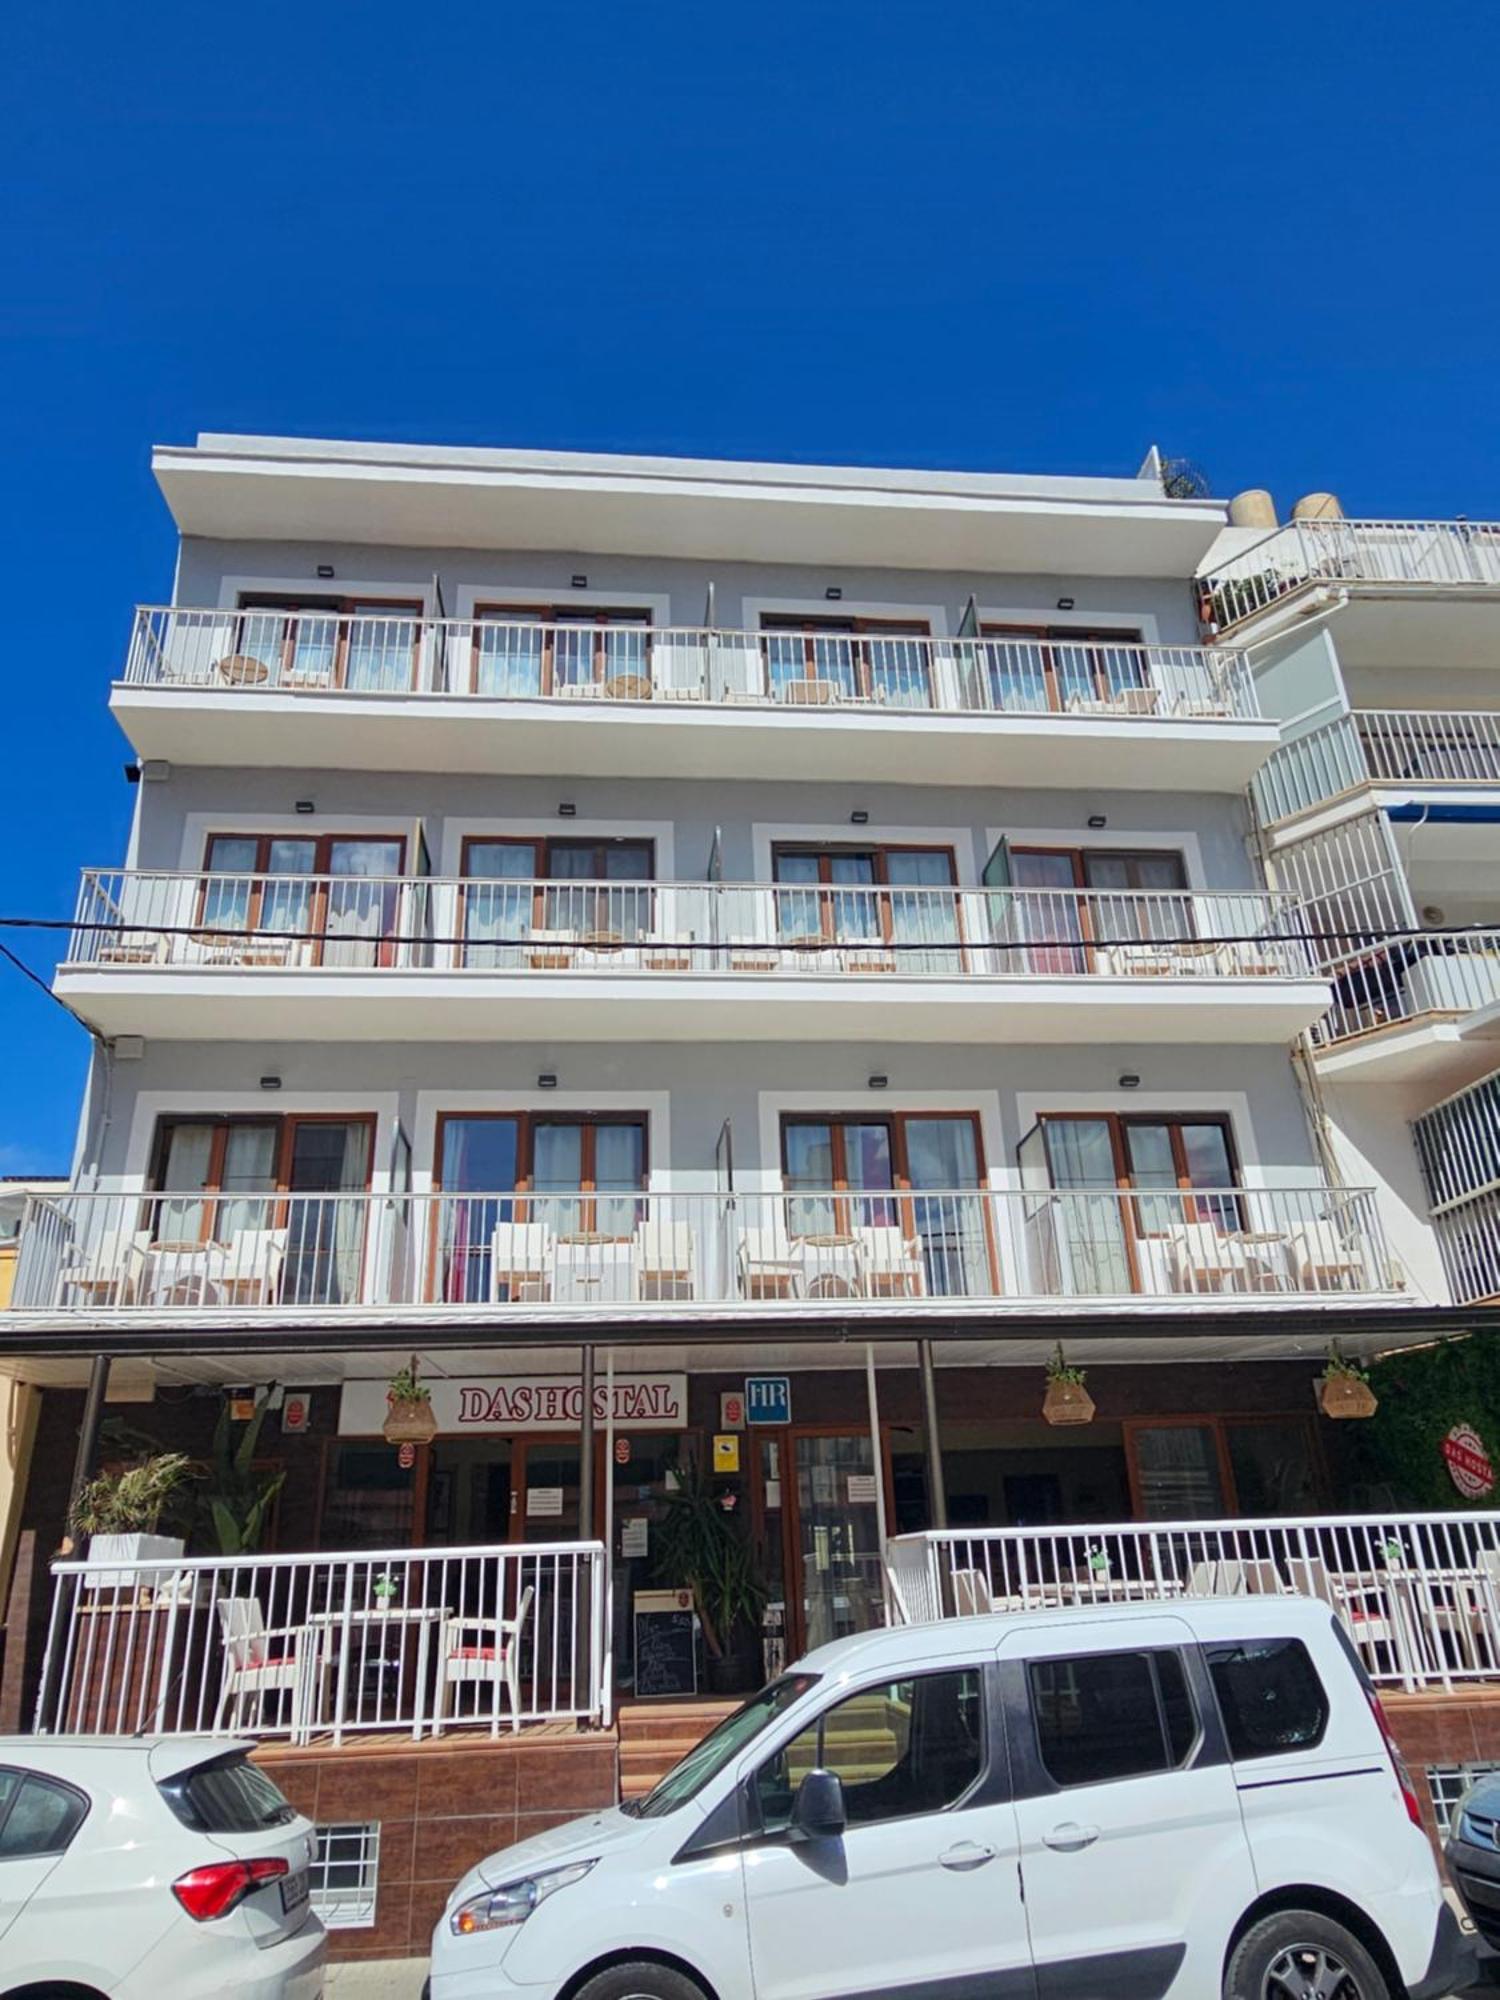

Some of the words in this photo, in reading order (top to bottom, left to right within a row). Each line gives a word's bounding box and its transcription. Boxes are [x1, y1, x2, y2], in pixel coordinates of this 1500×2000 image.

[459, 1386, 532, 1422] DAS
[535, 1384, 678, 1420] HOSTAL
[750, 1383, 786, 1407] HR
